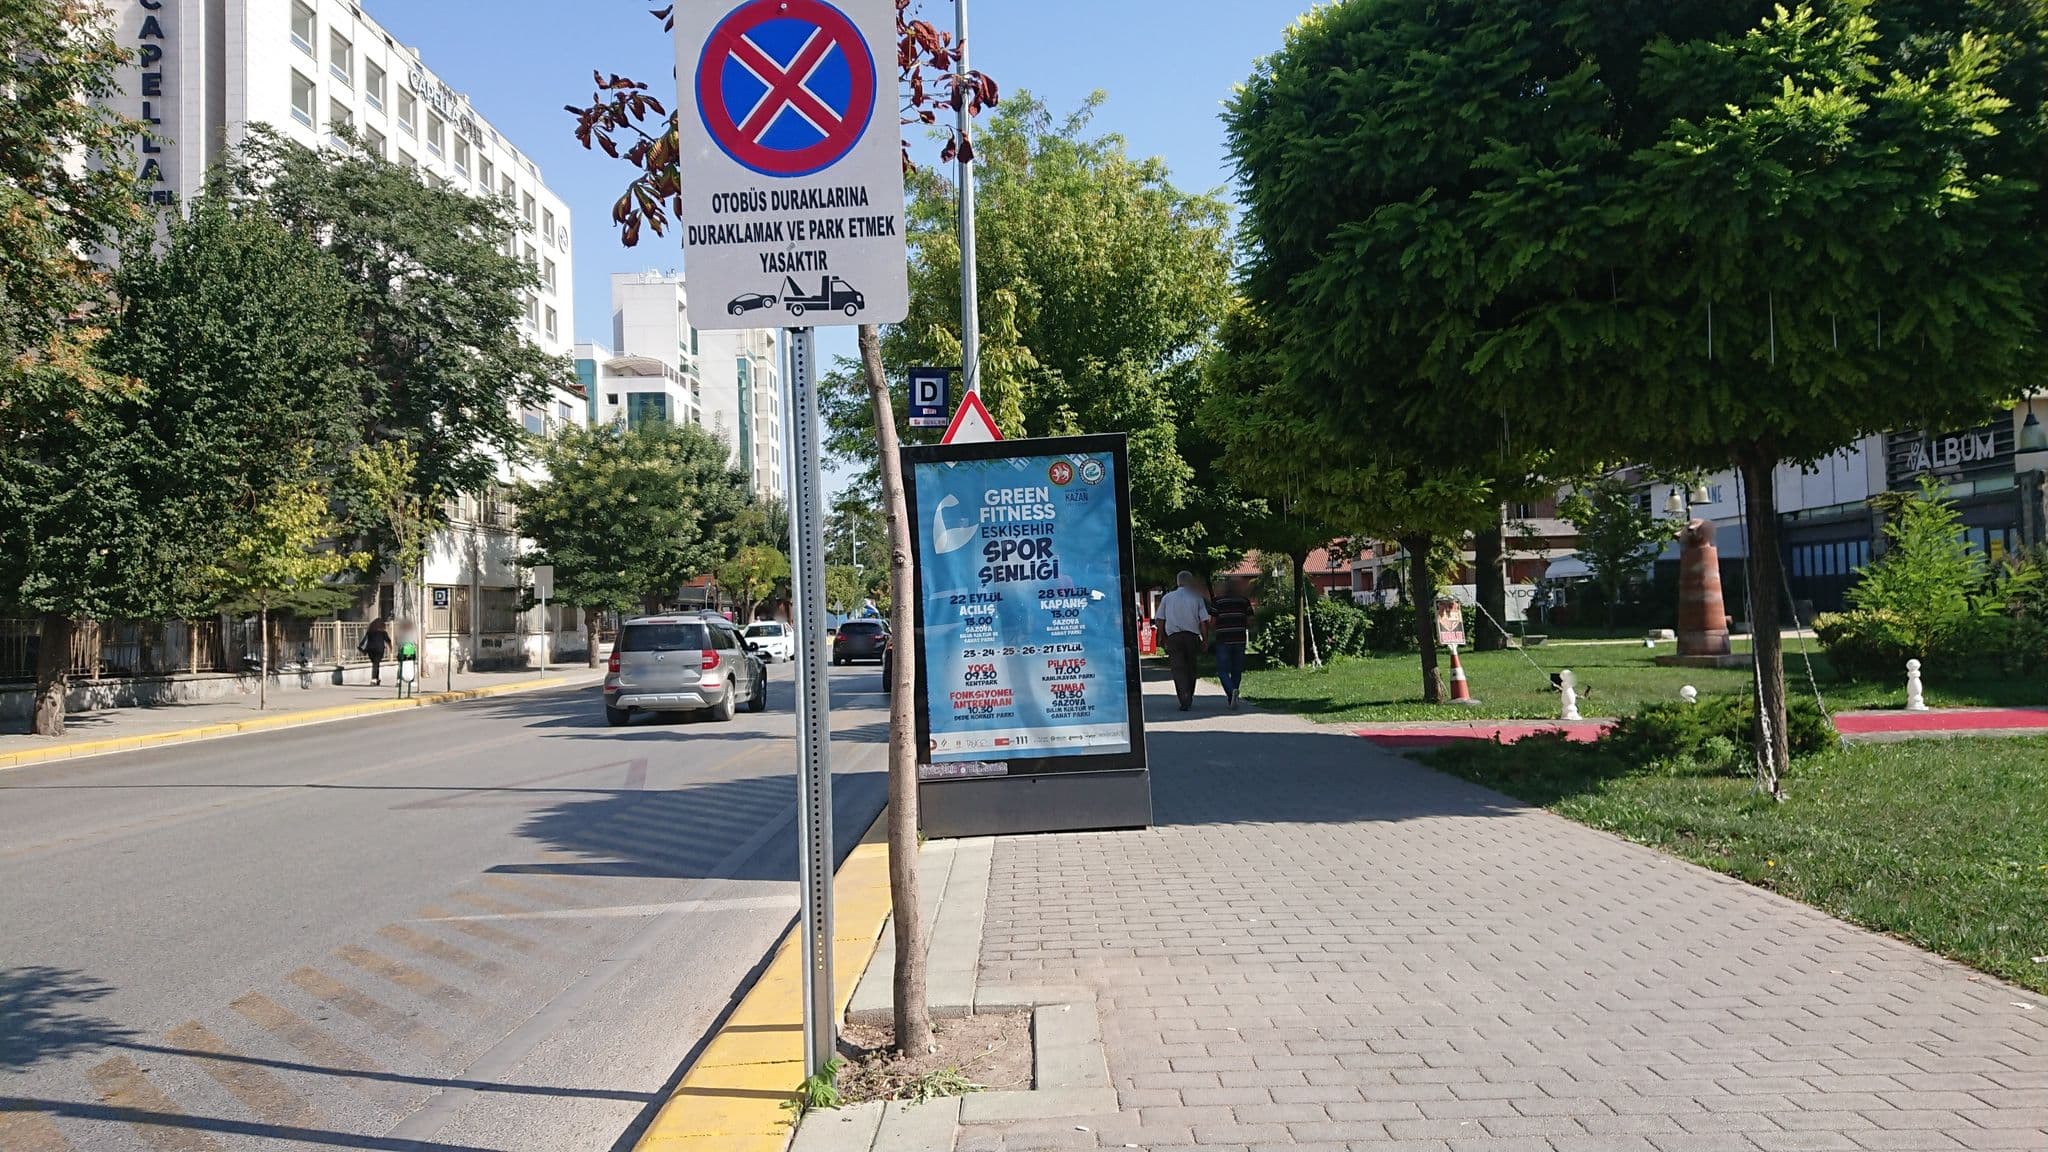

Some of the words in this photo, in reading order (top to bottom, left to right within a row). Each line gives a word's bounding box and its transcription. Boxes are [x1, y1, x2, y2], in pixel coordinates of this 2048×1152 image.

[408, 69, 461, 130] CAPELLA
[712, 187, 767, 214] OTOBÜS
[771, 186, 869, 211] DURAKLARINA
[688, 221, 784, 246] DURAKLAMAK
[786, 220, 805, 241] VE
[809, 218, 845, 240] PARK
[849, 216, 896, 238] ETMEK
[759, 250, 828, 273] YASAKTIR
[920, 381, 938, 402] D
[1917, 430, 1995, 472] ALBÜM
[985, 487, 1049, 505] GREEN
[980, 503, 1056, 523] FITNESS
[981, 521, 1054, 538] ESKİŞEHİR
[983, 537, 1054, 562] SPOR
[978, 559, 1059, 588] ŞENLİĞİ
[950, 594, 966, 605] 22
[969, 592, 1003, 604] EYLÜL
[1038, 588, 1055, 599] 28
[1057, 587, 1090, 598] EYLÜL
[960, 603, 996, 618] AÇILIŞ
[1040, 597, 1088, 610] KAPANIŞ
[963, 649, 976, 658] 23
[982, 648, 995, 657] 24
[1002, 647, 1015, 656] 25
[1022, 646, 1036, 655] 26
[1043, 645, 1054, 653] 27
[1056, 643, 1083, 652] EYLÜL
[967, 664, 995, 672] YOGA
[965, 679, 998, 687] KENTPARK
[1051, 683, 1085, 692] ZUMBA
[953, 698, 1012, 709] ANTRENMAN
[1052, 698, 1086, 707] SAZOVA
